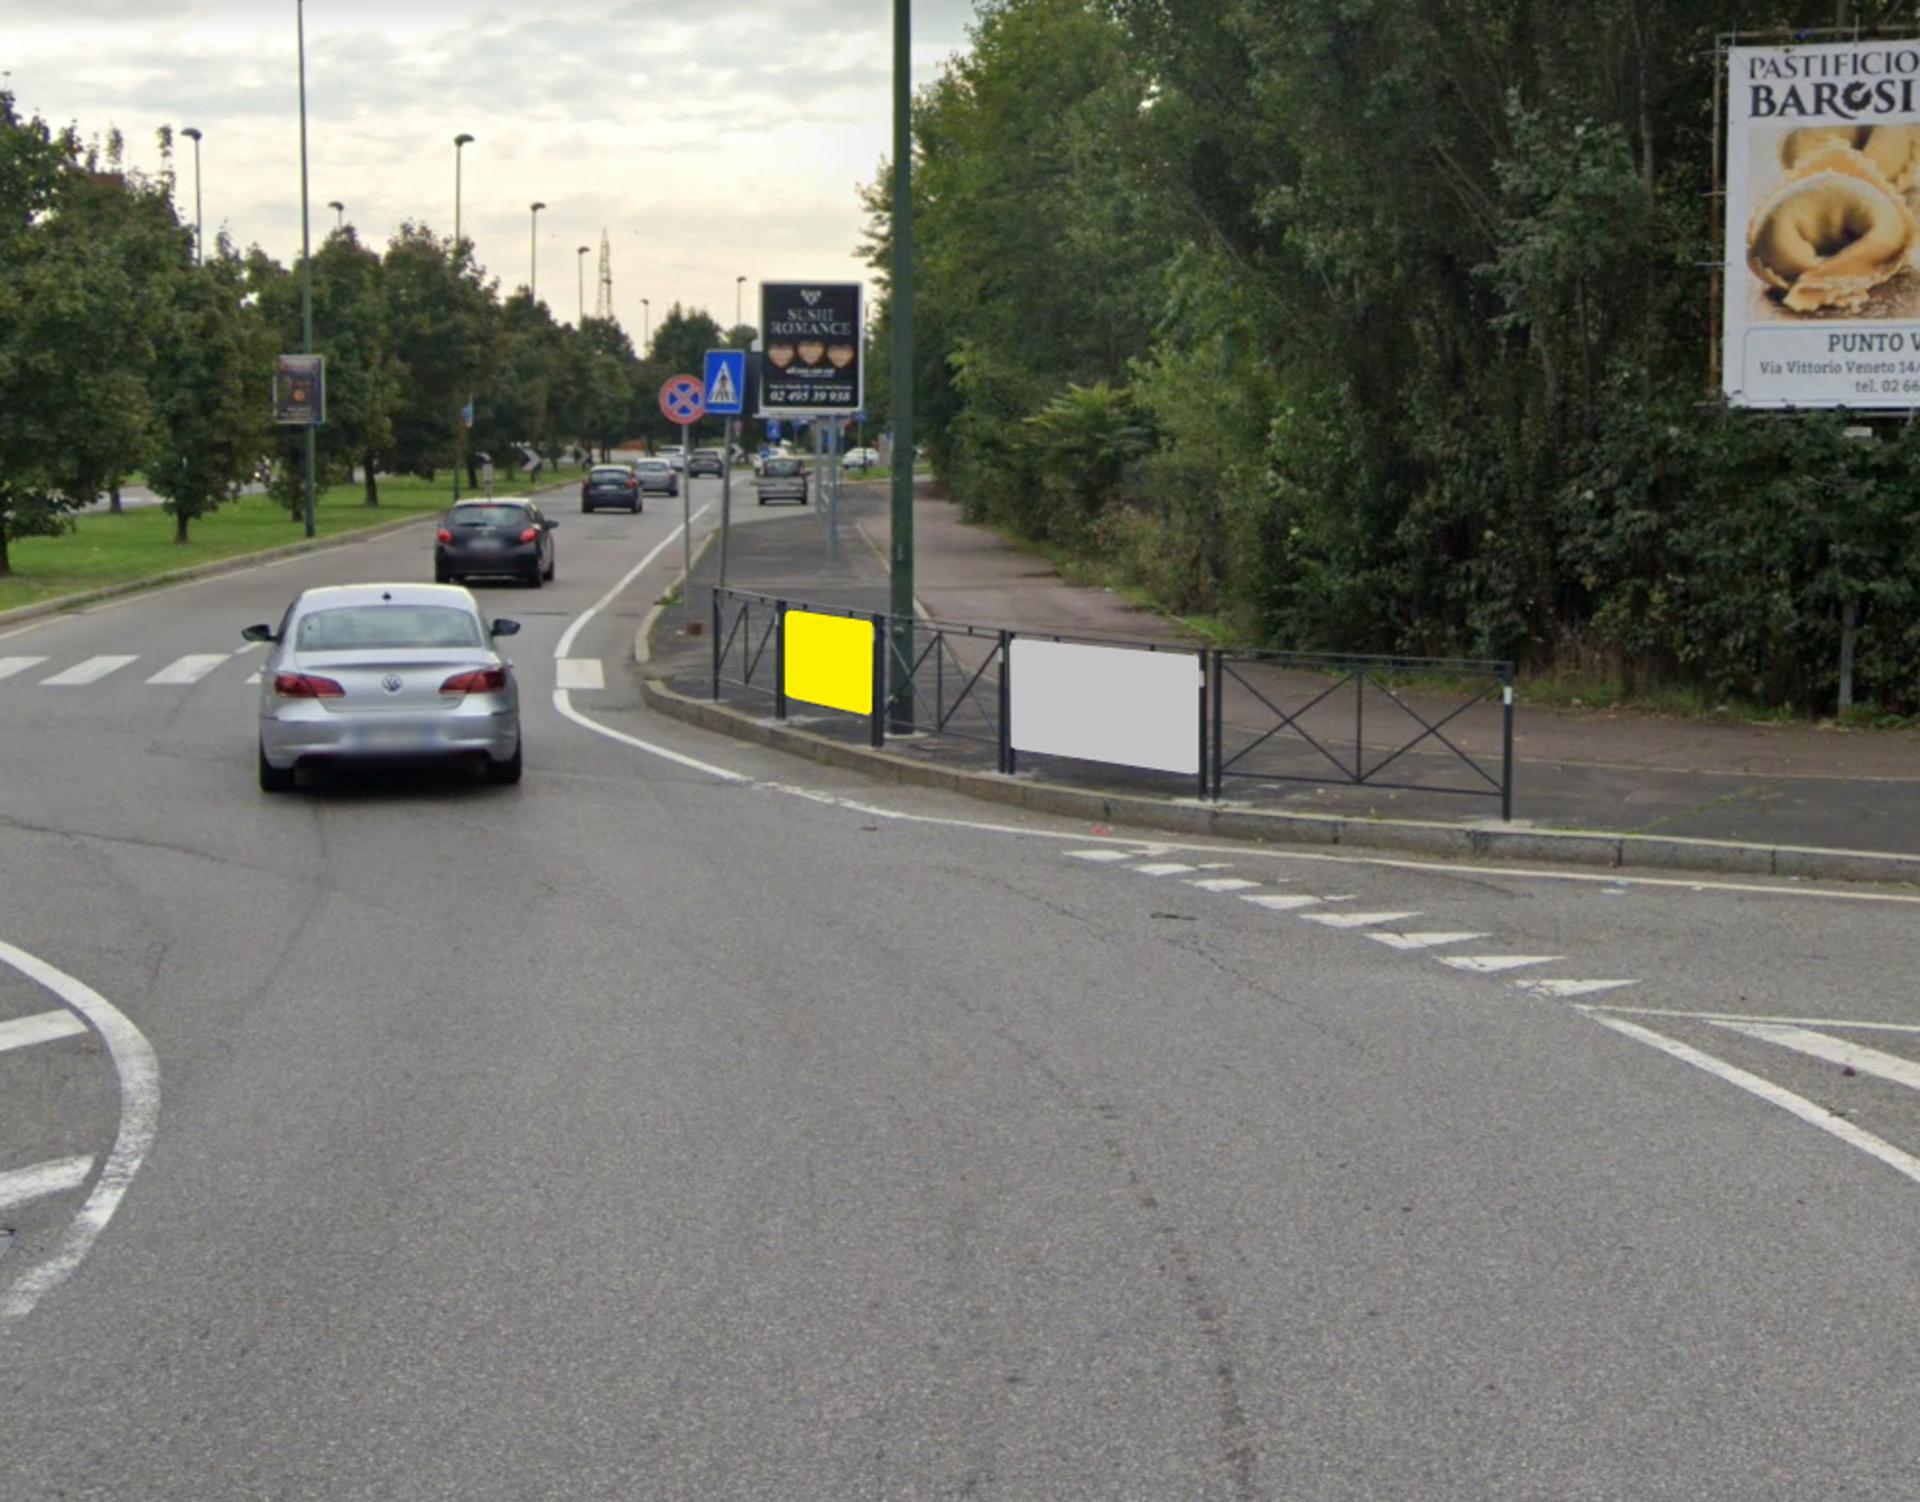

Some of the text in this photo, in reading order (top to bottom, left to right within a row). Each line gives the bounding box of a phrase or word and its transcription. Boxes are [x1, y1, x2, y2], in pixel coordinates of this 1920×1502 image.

[1749, 50, 1919, 79] PASTIFICIO
[1748, 79, 1917, 120] BAROSI
[787, 308, 834, 321] SUSHI
[771, 321, 851, 335] ROMANCE
[1828, 333, 1904, 353] PUNTO
[1760, 361, 1783, 375] Via
[1786, 359, 1842, 375] Vittorio
[1845, 360, 1896, 374] Veneto
[1855, 379, 1877, 393] tel.
[1882, 380, 1900, 393] 02
